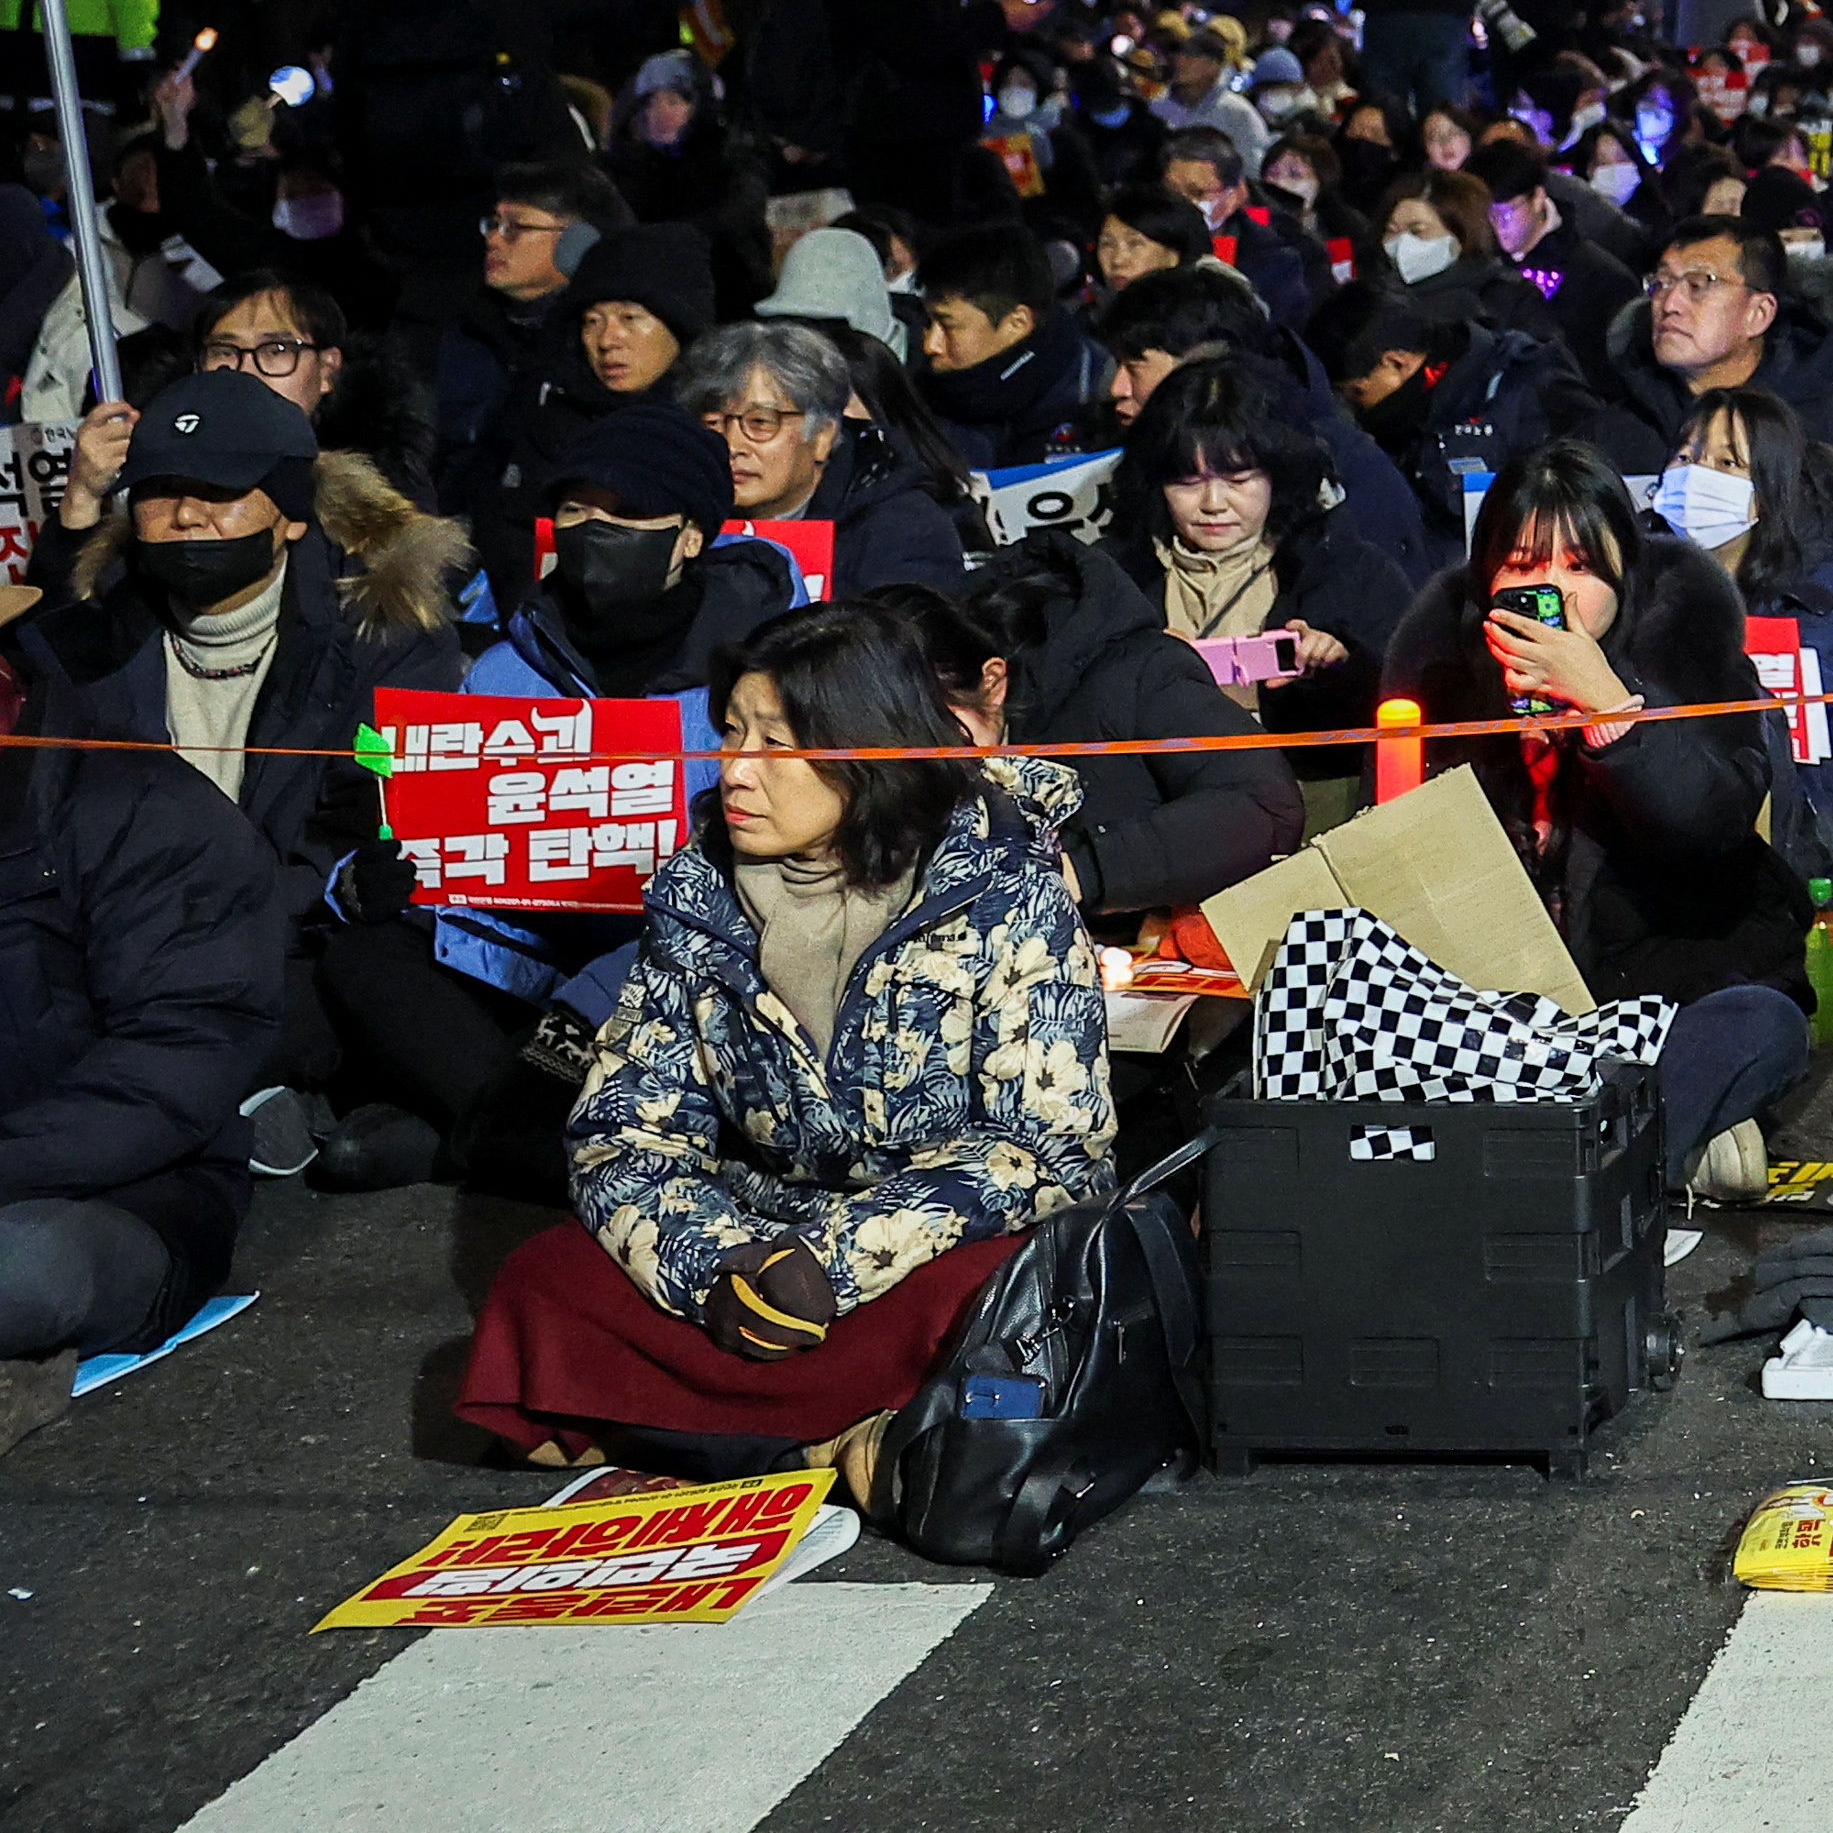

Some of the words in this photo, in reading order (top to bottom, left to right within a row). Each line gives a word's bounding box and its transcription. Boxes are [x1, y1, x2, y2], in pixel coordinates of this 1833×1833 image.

[381, 698, 594, 772] 내란수괴
[487, 759, 675, 826] 윤석열
[528, 818, 678, 884] 탄핵!
[416, 1483, 815, 1568] 해체하라!
[391, 1575, 769, 1625] 내란동조
[401, 1541, 764, 1599] 국민의힘
